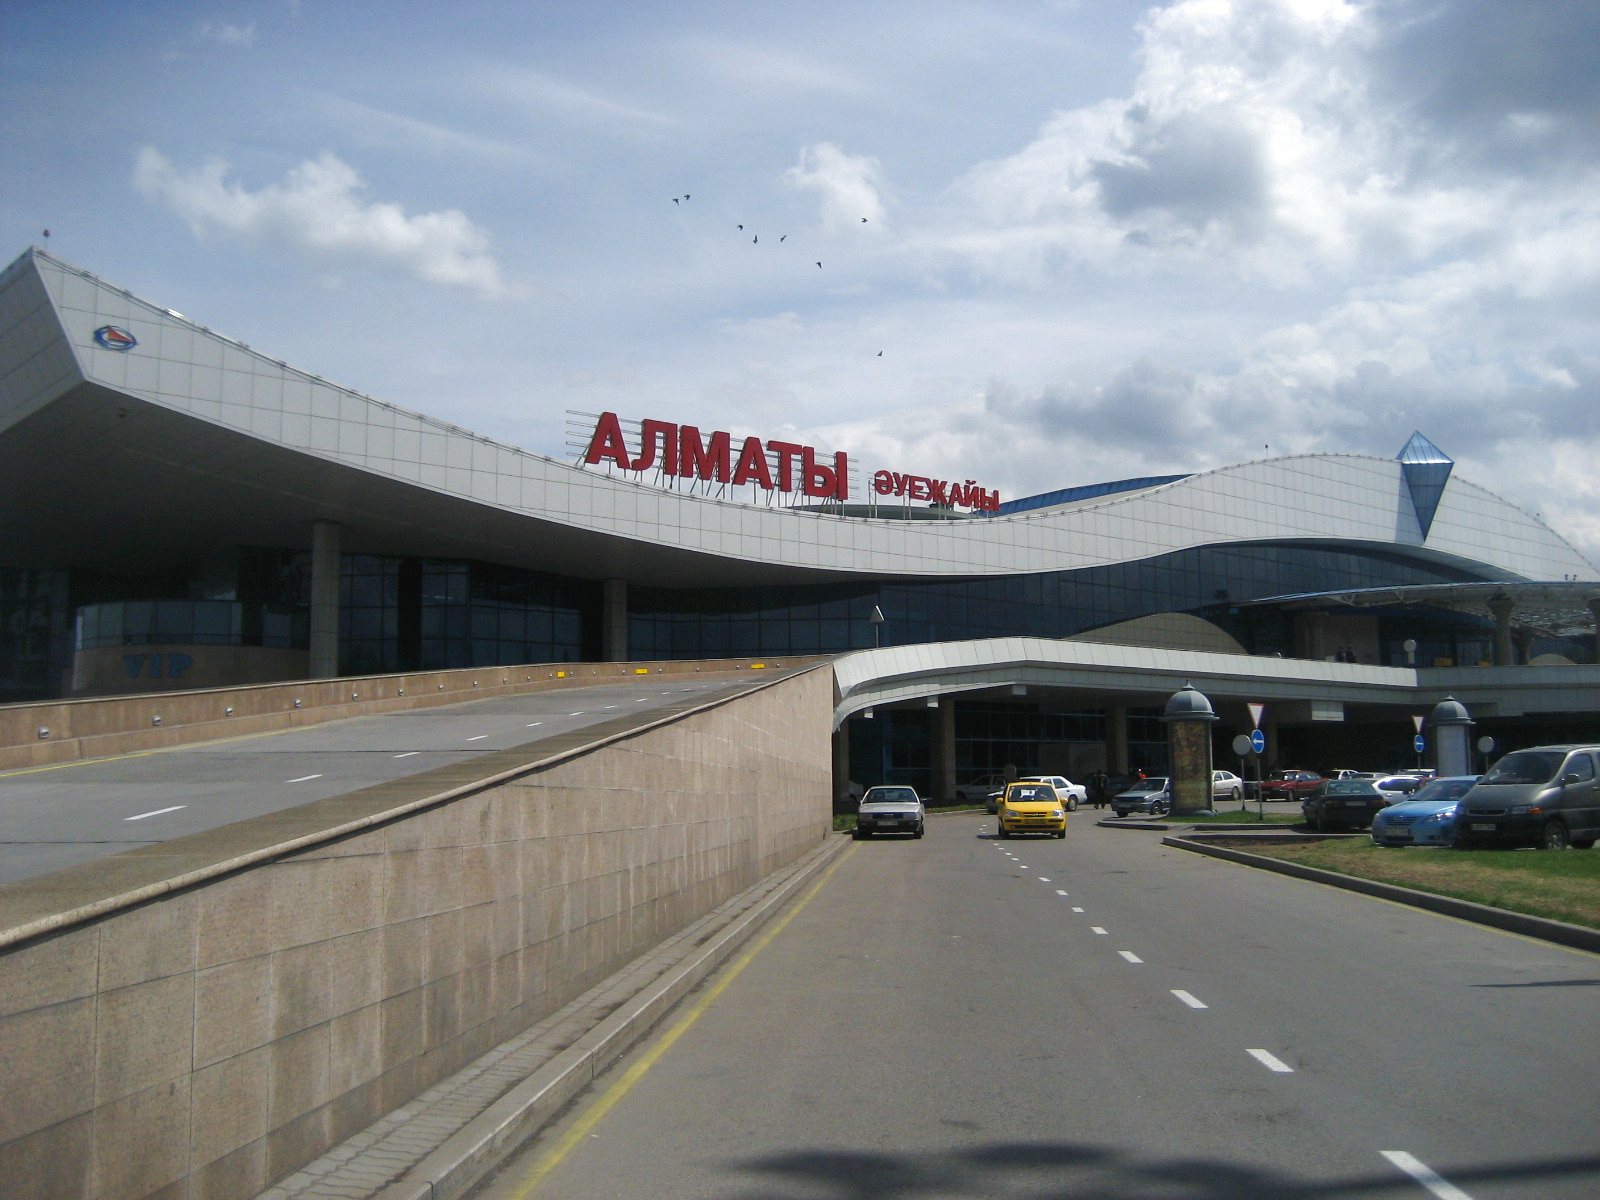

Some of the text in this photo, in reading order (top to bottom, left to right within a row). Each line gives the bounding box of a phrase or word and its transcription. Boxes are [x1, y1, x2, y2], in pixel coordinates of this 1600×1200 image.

[584, 411, 1000, 512] АЛМАТЫ ӘУЕЖАЙЫ
[123, 653, 193, 678] VIP
